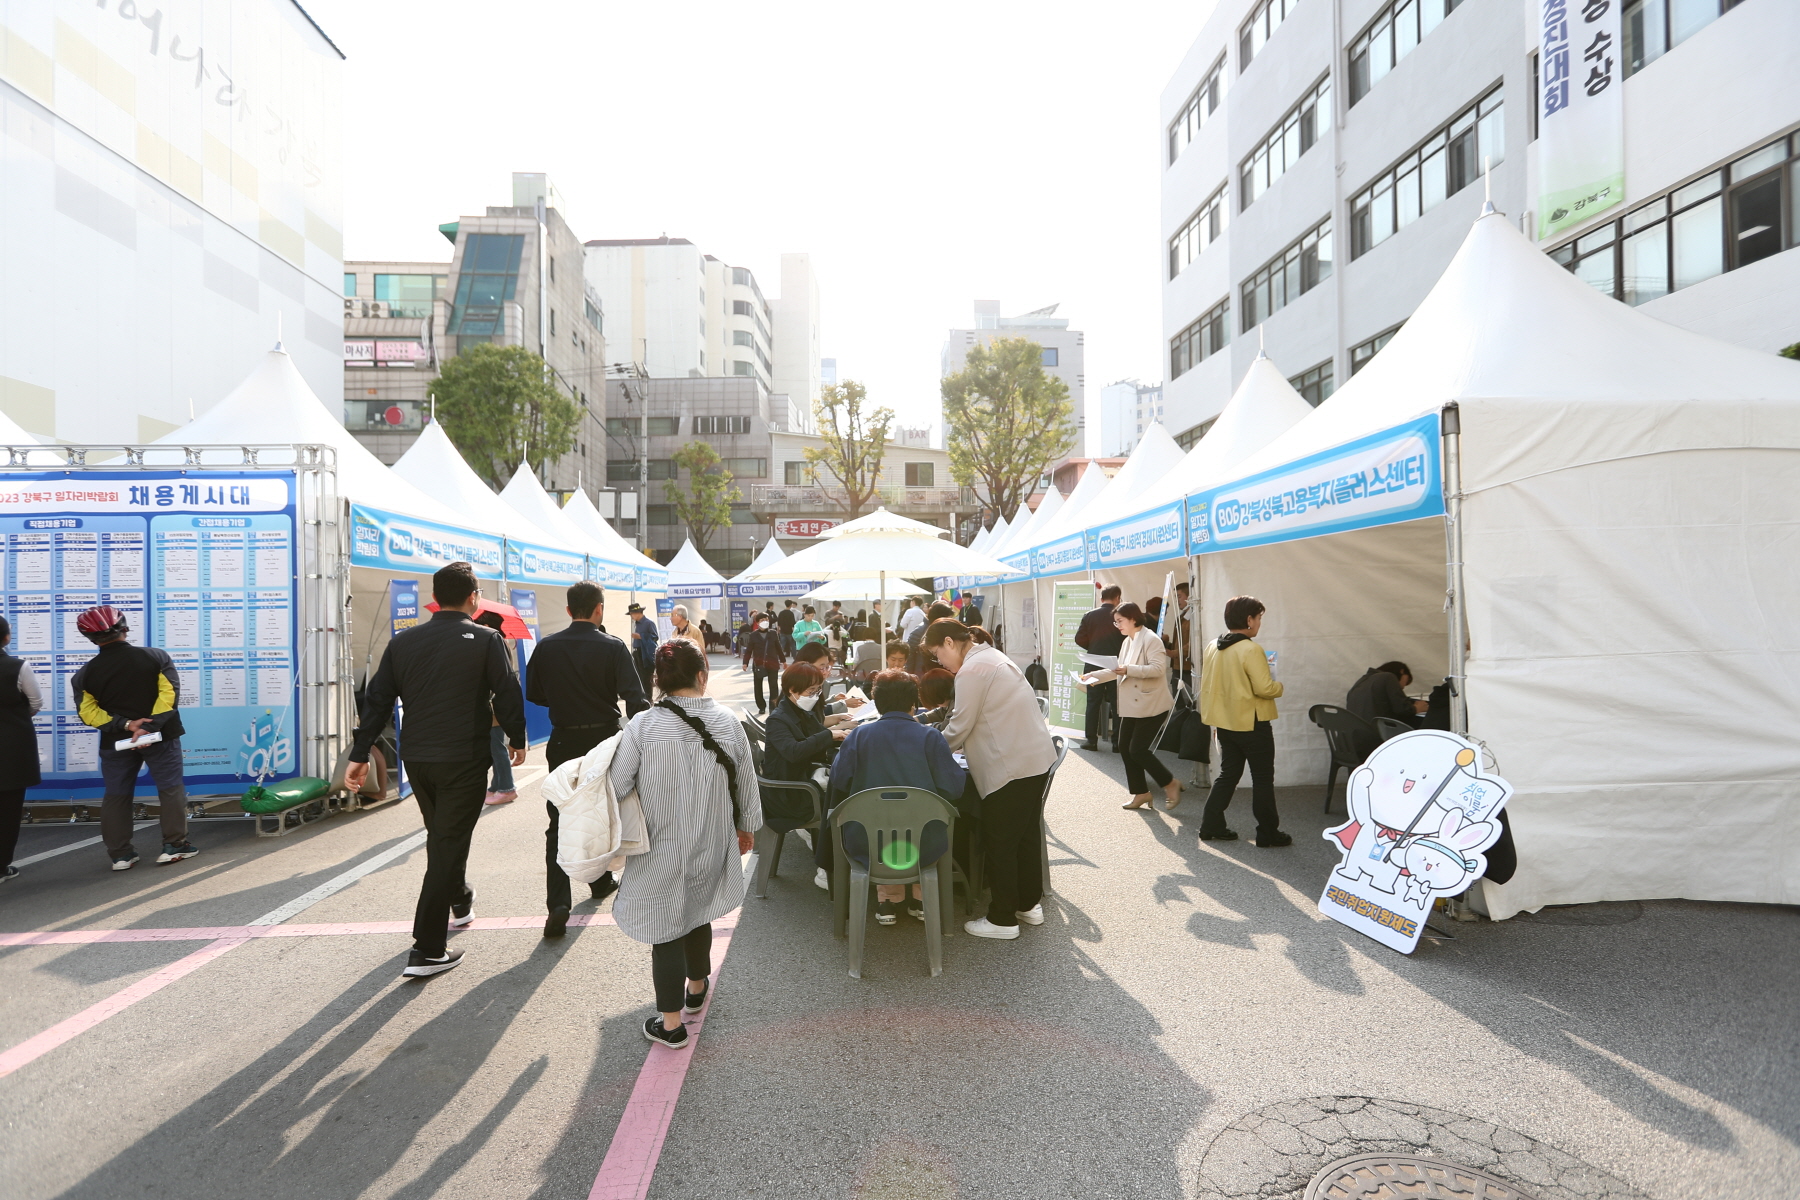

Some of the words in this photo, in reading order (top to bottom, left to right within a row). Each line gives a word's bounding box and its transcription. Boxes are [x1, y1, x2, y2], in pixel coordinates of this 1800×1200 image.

[1584, 29, 1614, 97] 수상
[1573, 186, 1611, 211] 강북구
[345, 345, 374, 357] 마사지
[909, 430, 926, 439] BAR
[22, 492, 52, 503] 강북구
[55, 491, 119, 502] 일자리박람회
[129, 485, 250, 506] 채용게시대
[1219, 504, 1240, 527] B06
[1241, 453, 1425, 525] 강북성북고용복지플러스센터
[29, 519, 77, 529] 직접채용기업
[198, 518, 246, 527] 간접채용기업
[1190, 512, 1208, 529] 일자리
[355, 525, 380, 542] 일자리
[1111, 535, 1125, 554] 강북구
[1126, 521, 1179, 550] 사회적경제지원센터
[1191, 528, 1210, 544] 박람회
[355, 541, 380, 557] 박람회
[414, 537, 441, 558] 강북구
[442, 543, 500, 566] 일자리플러스센터
[1052, 662, 1063, 709] 진로탐색
[1061, 674, 1072, 722] 힐링타로
[1326, 884, 1418, 938] 국민취업지원제도
